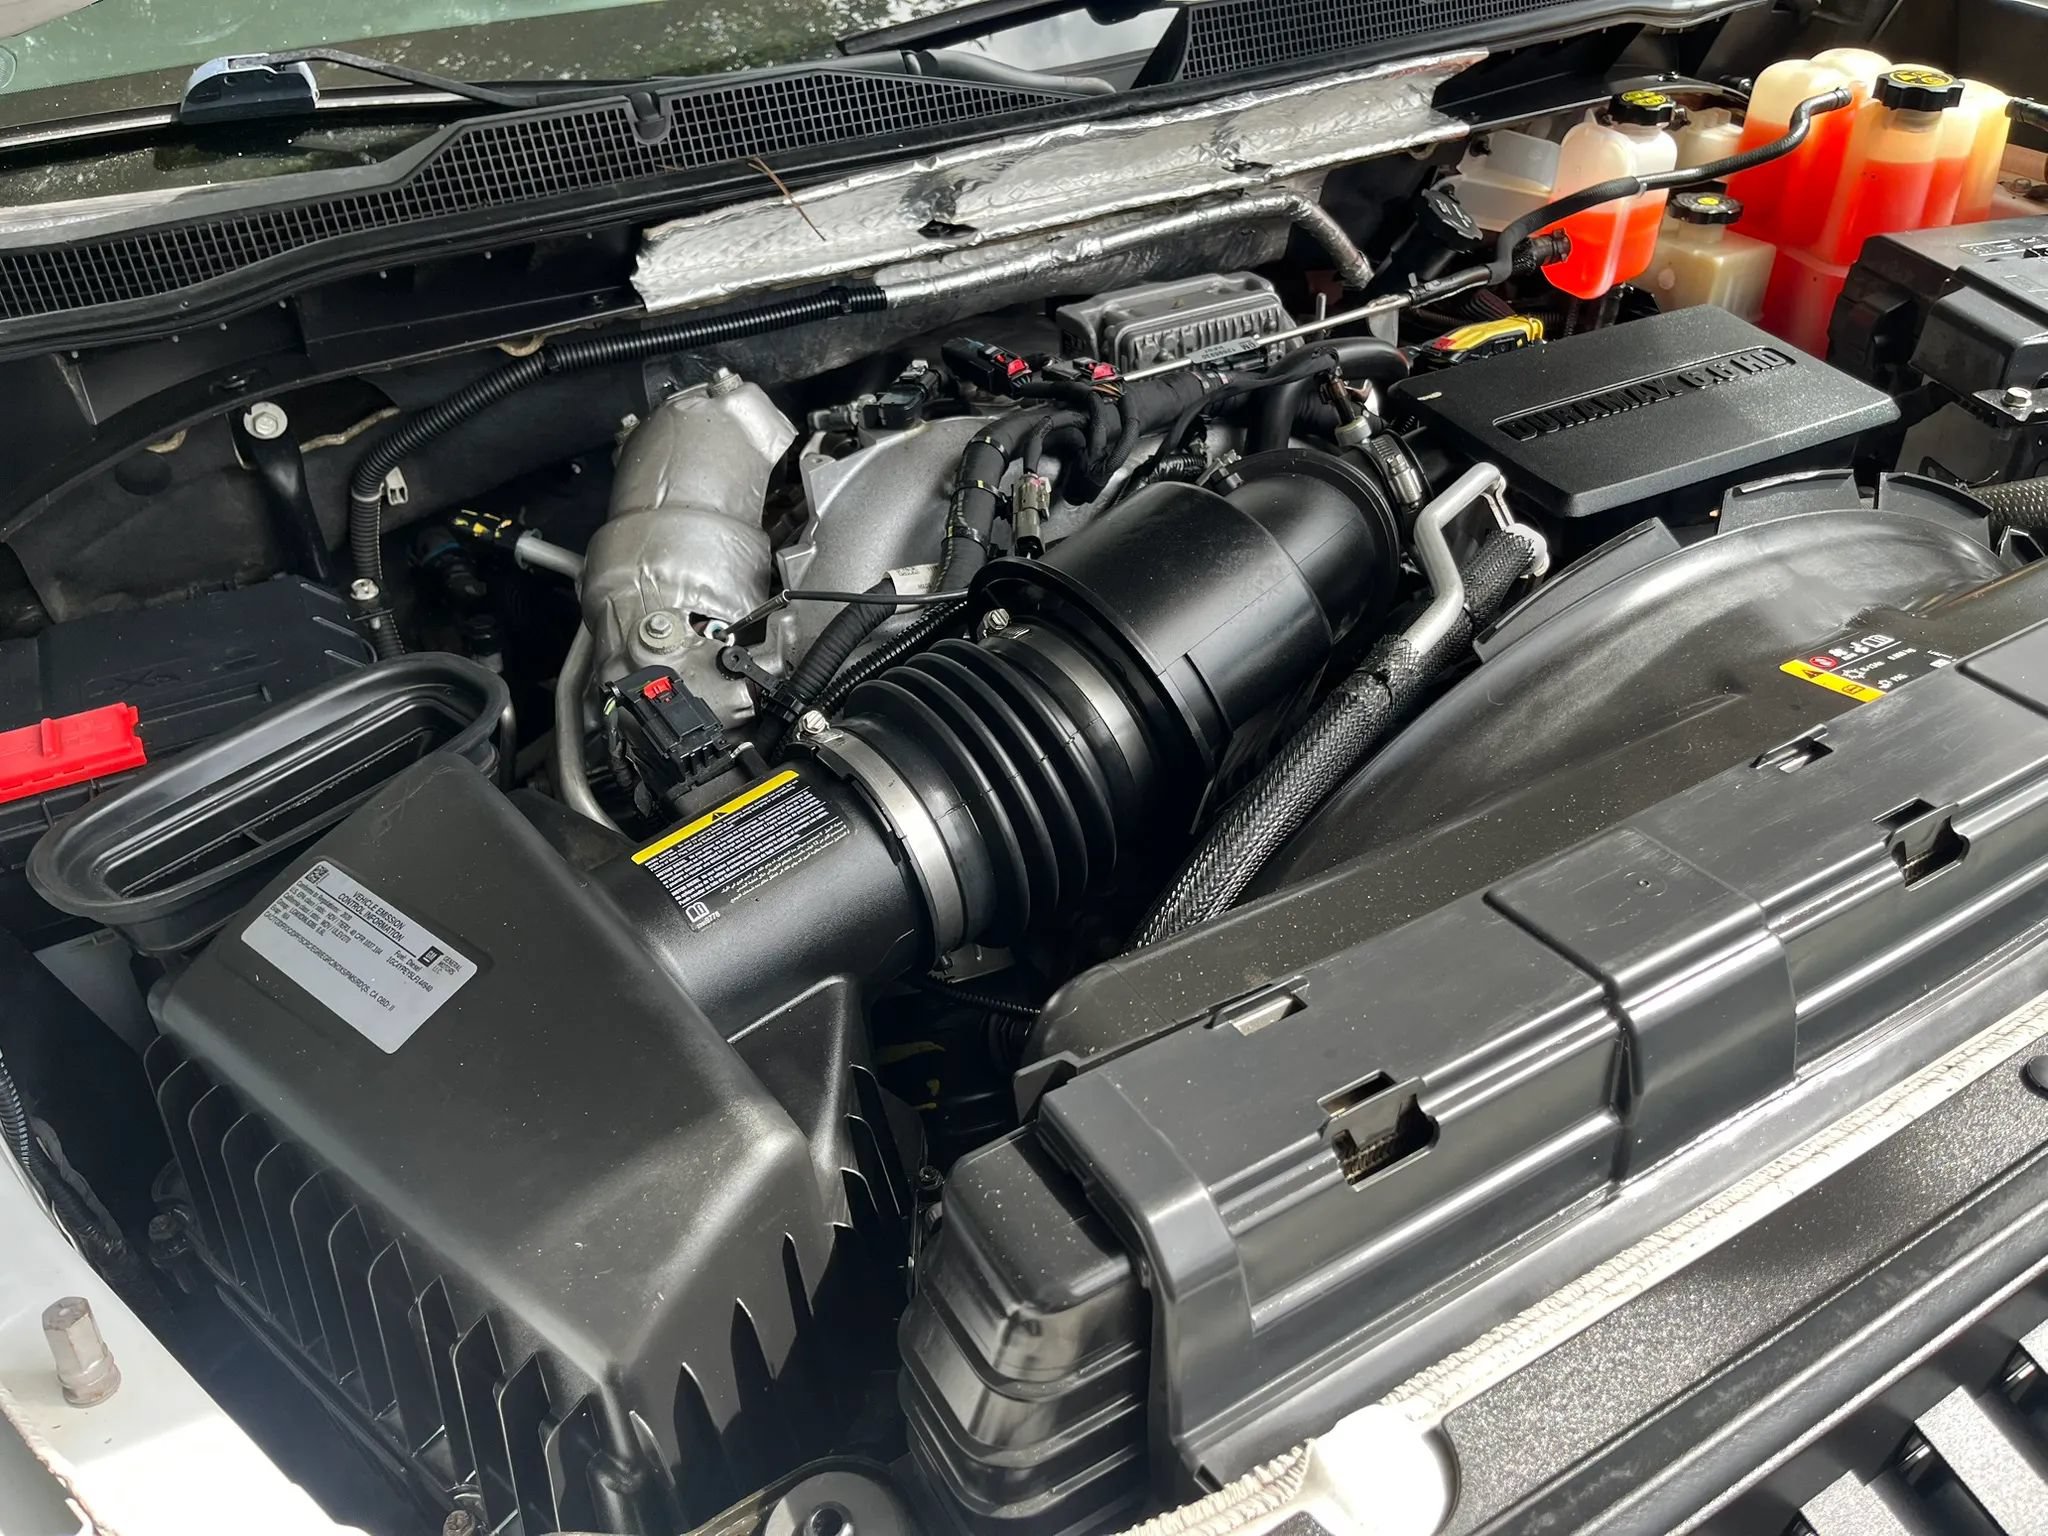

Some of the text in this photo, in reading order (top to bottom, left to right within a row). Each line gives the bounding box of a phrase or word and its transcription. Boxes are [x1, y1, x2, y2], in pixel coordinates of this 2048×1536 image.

[1498, 350, 1790, 442] DURAMAX 6.6 HD
[336, 892, 405, 942] CONTROL INFORMATION
[351, 890, 406, 930] VEHICLE EMISSION
[405, 958, 423, 972] Diesel
[441, 955, 463, 972] GENERAL
